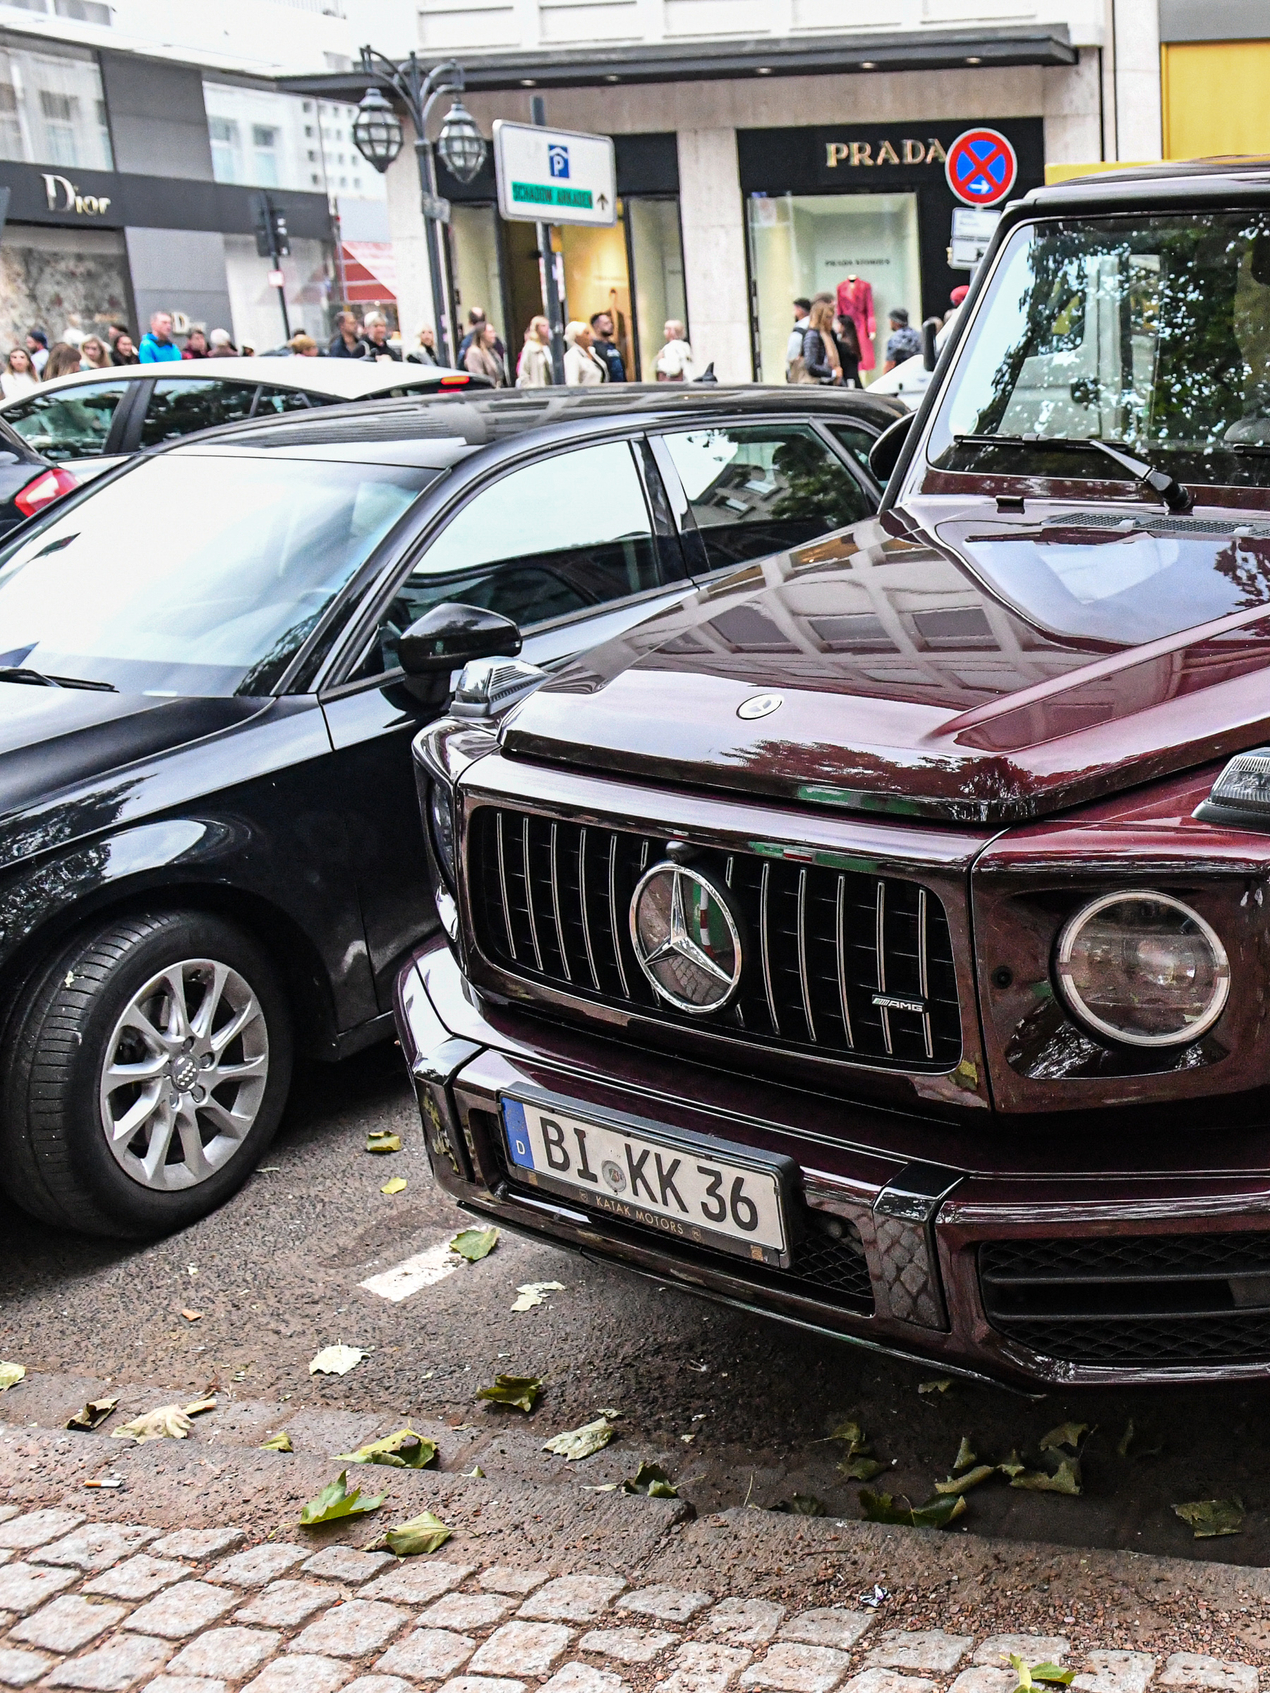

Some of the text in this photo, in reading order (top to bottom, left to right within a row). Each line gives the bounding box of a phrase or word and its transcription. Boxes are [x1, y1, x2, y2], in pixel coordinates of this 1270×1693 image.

[826, 138, 946, 167] PRADA
[41, 173, 111, 216] Dior
[888, 1001, 922, 1011] AMG
[516, 1140, 525, 1155] D
[540, 1116, 758, 1231] BI KK 36
[596, 1197, 683, 1234] KATAK MOTORS
